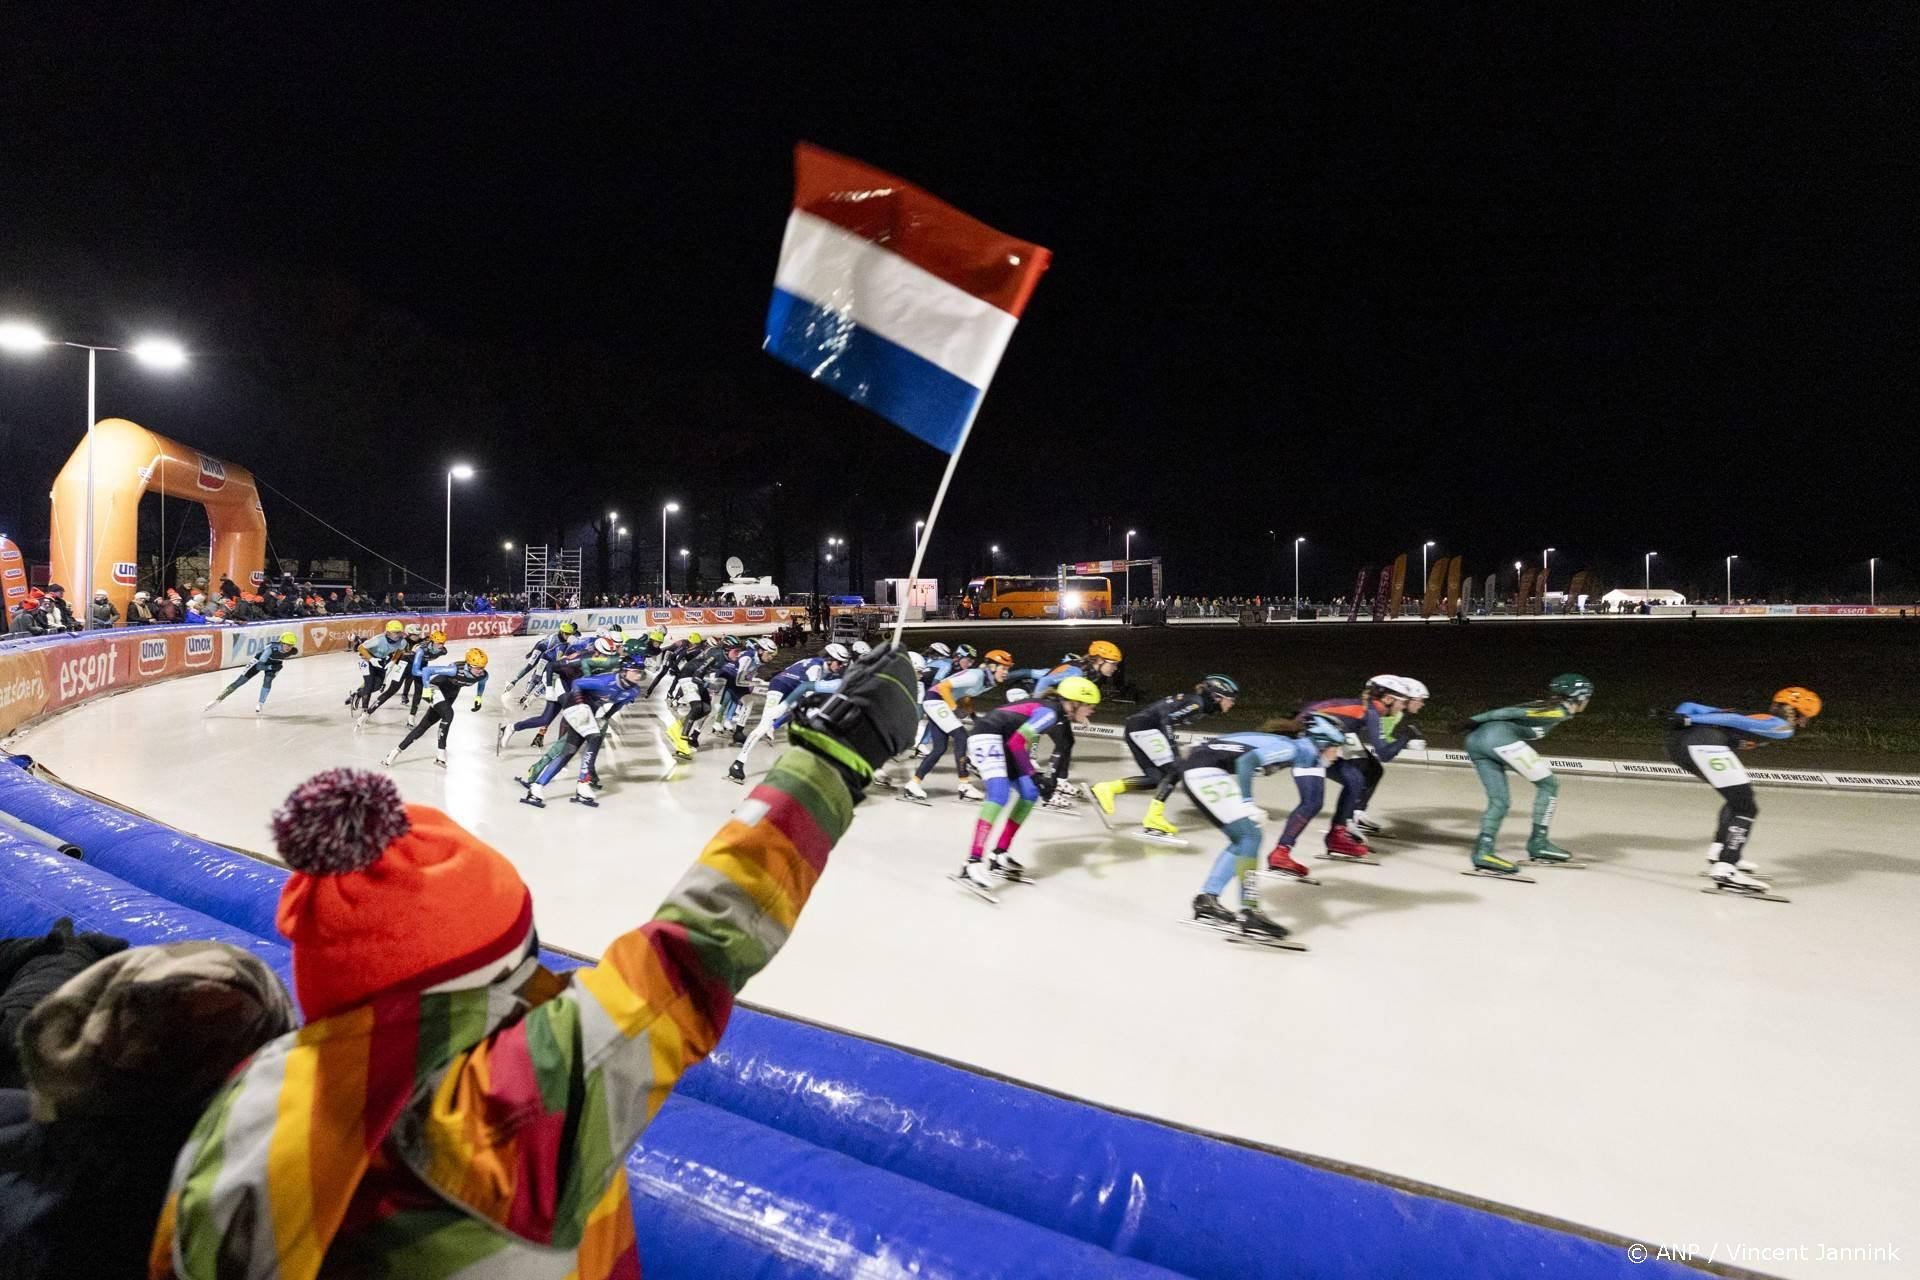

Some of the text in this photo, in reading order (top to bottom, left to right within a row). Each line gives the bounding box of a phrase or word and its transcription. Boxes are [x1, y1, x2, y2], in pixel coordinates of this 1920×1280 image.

[597, 615, 639, 627] DAIKIN
[60, 643, 118, 700] essent
[1550, 760, 1583, 769] VELTHUIS
[1781, 773, 1823, 782] BEWEGING
[1835, 776, 1873, 784] WASSINK
